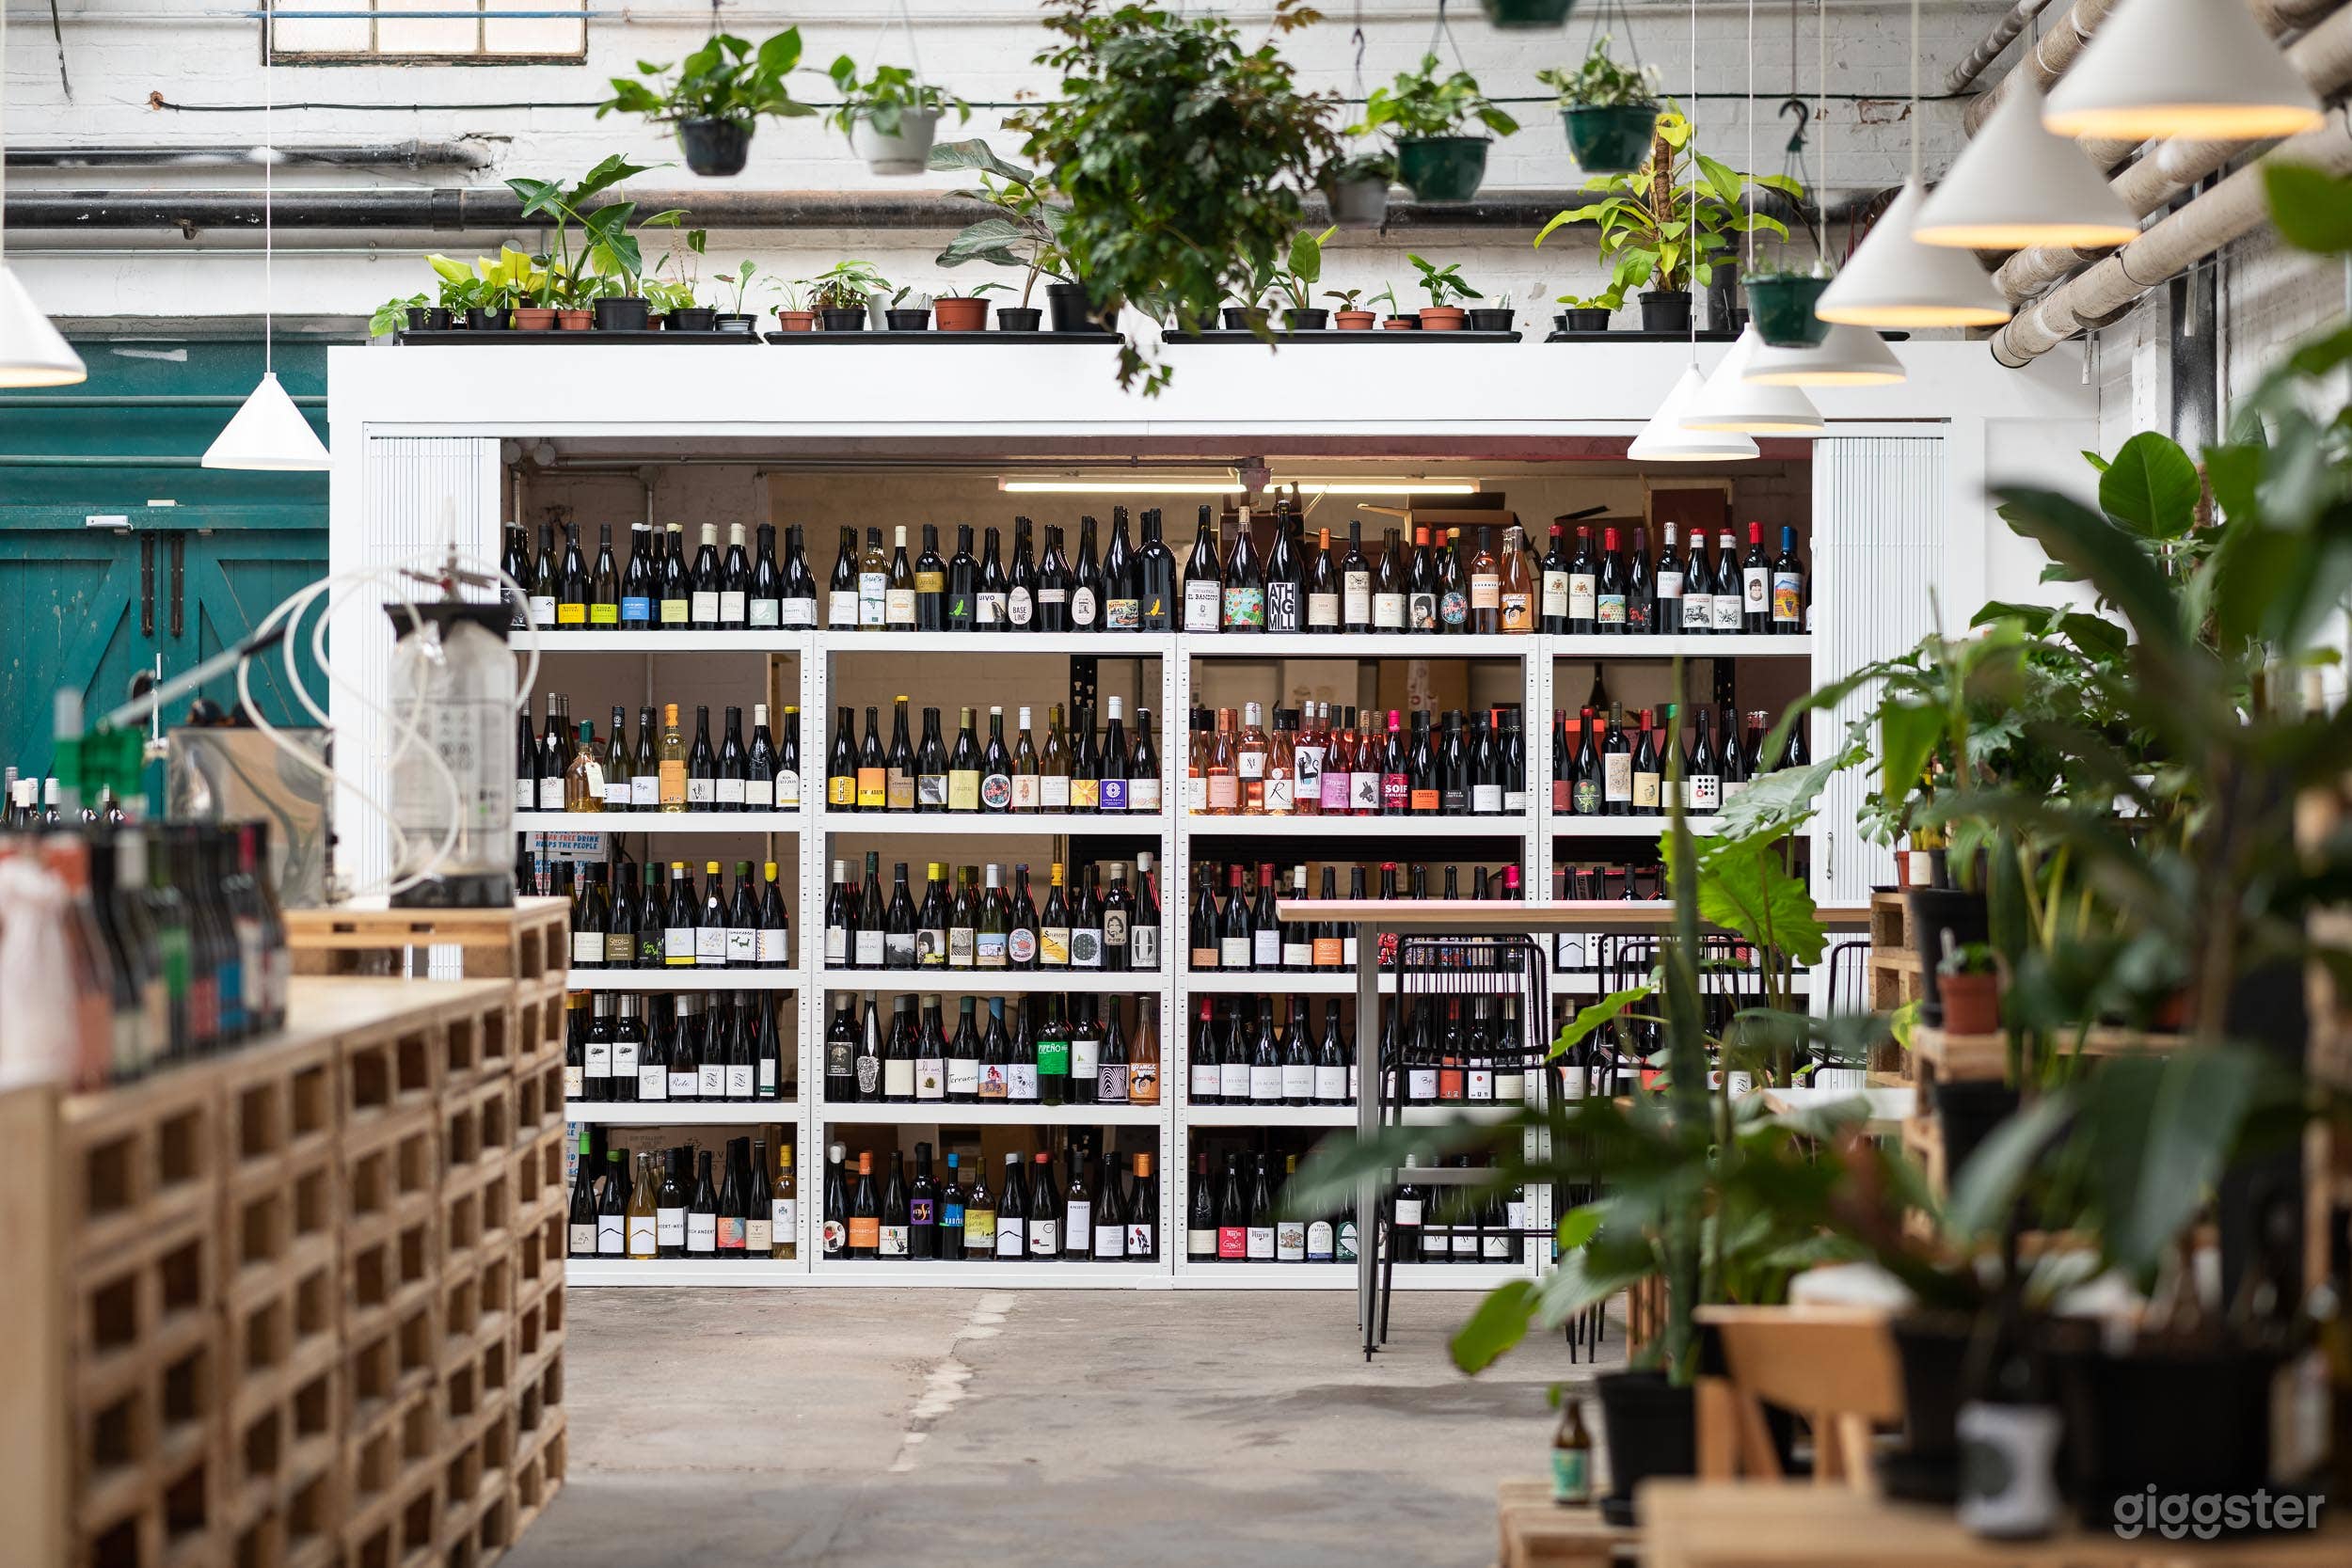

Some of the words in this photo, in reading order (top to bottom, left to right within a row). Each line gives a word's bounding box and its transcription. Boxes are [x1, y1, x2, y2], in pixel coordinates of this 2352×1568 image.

[1269, 614, 1295, 630] MILL
[1385, 783, 1408, 794] SOIF
[1131, 1064, 1156, 1072] ORANGE
